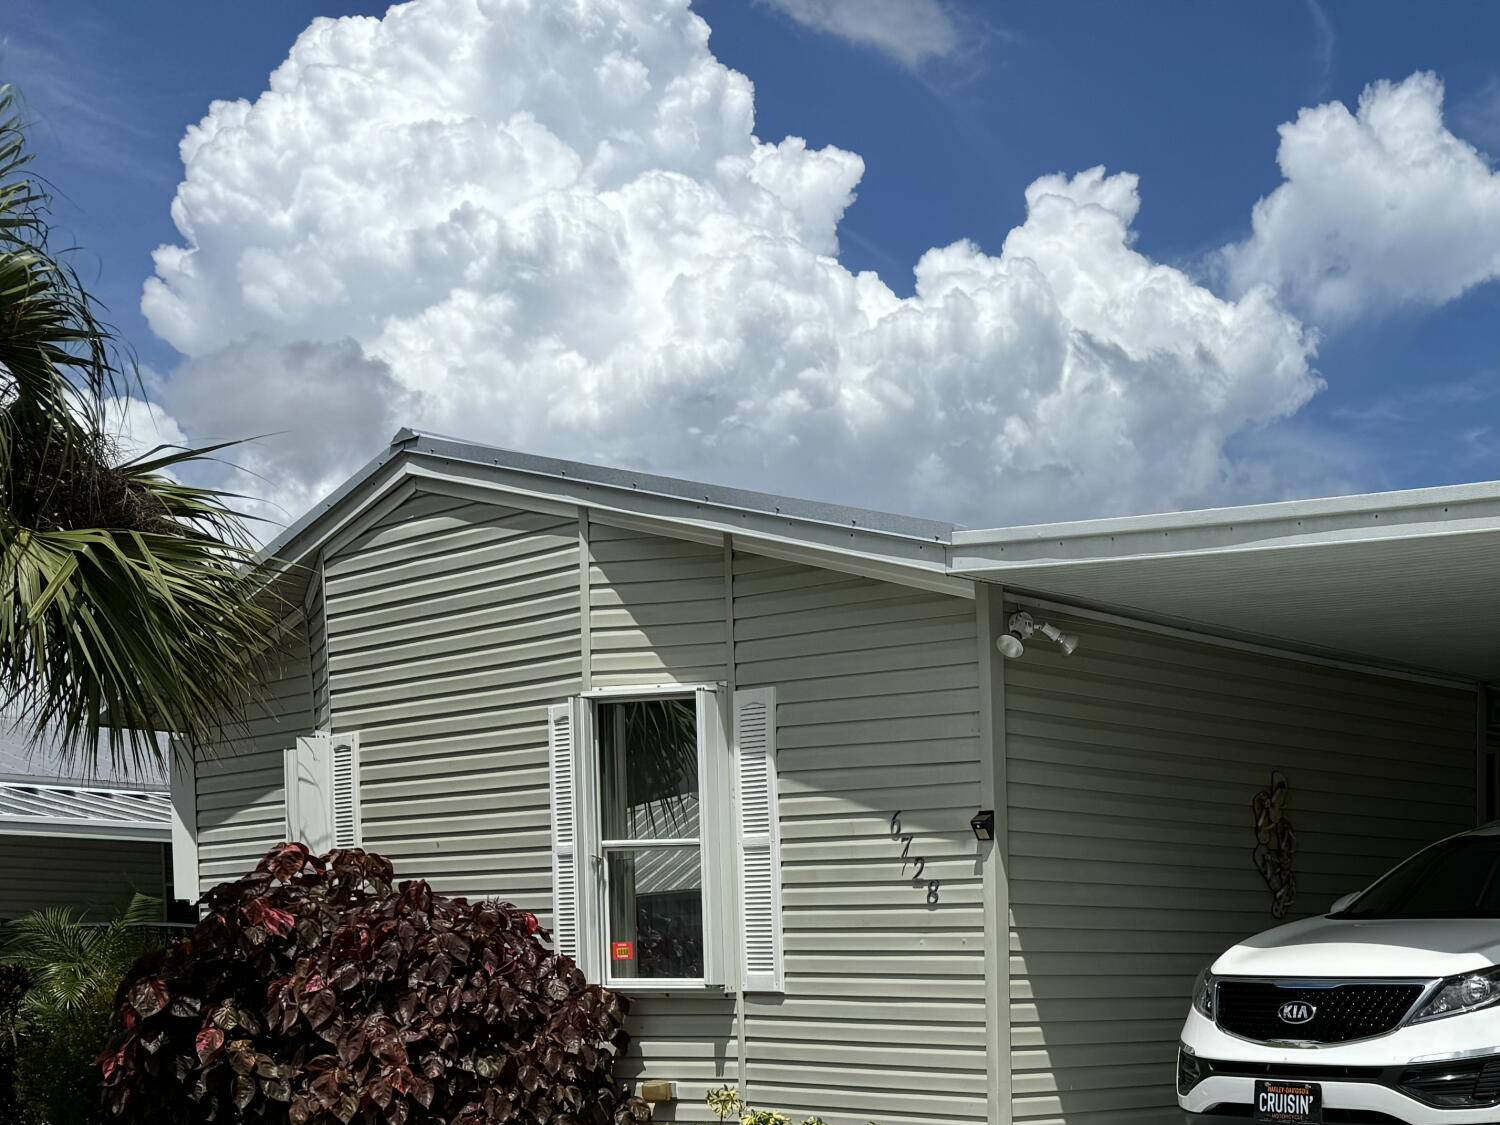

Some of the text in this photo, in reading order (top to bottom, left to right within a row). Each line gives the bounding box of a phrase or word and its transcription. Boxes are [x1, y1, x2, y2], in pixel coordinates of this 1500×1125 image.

[890, 809, 940, 910] 6728
[1283, 1005, 1309, 1019] KIA
[1259, 1092, 1314, 1115] CRUISIN'
